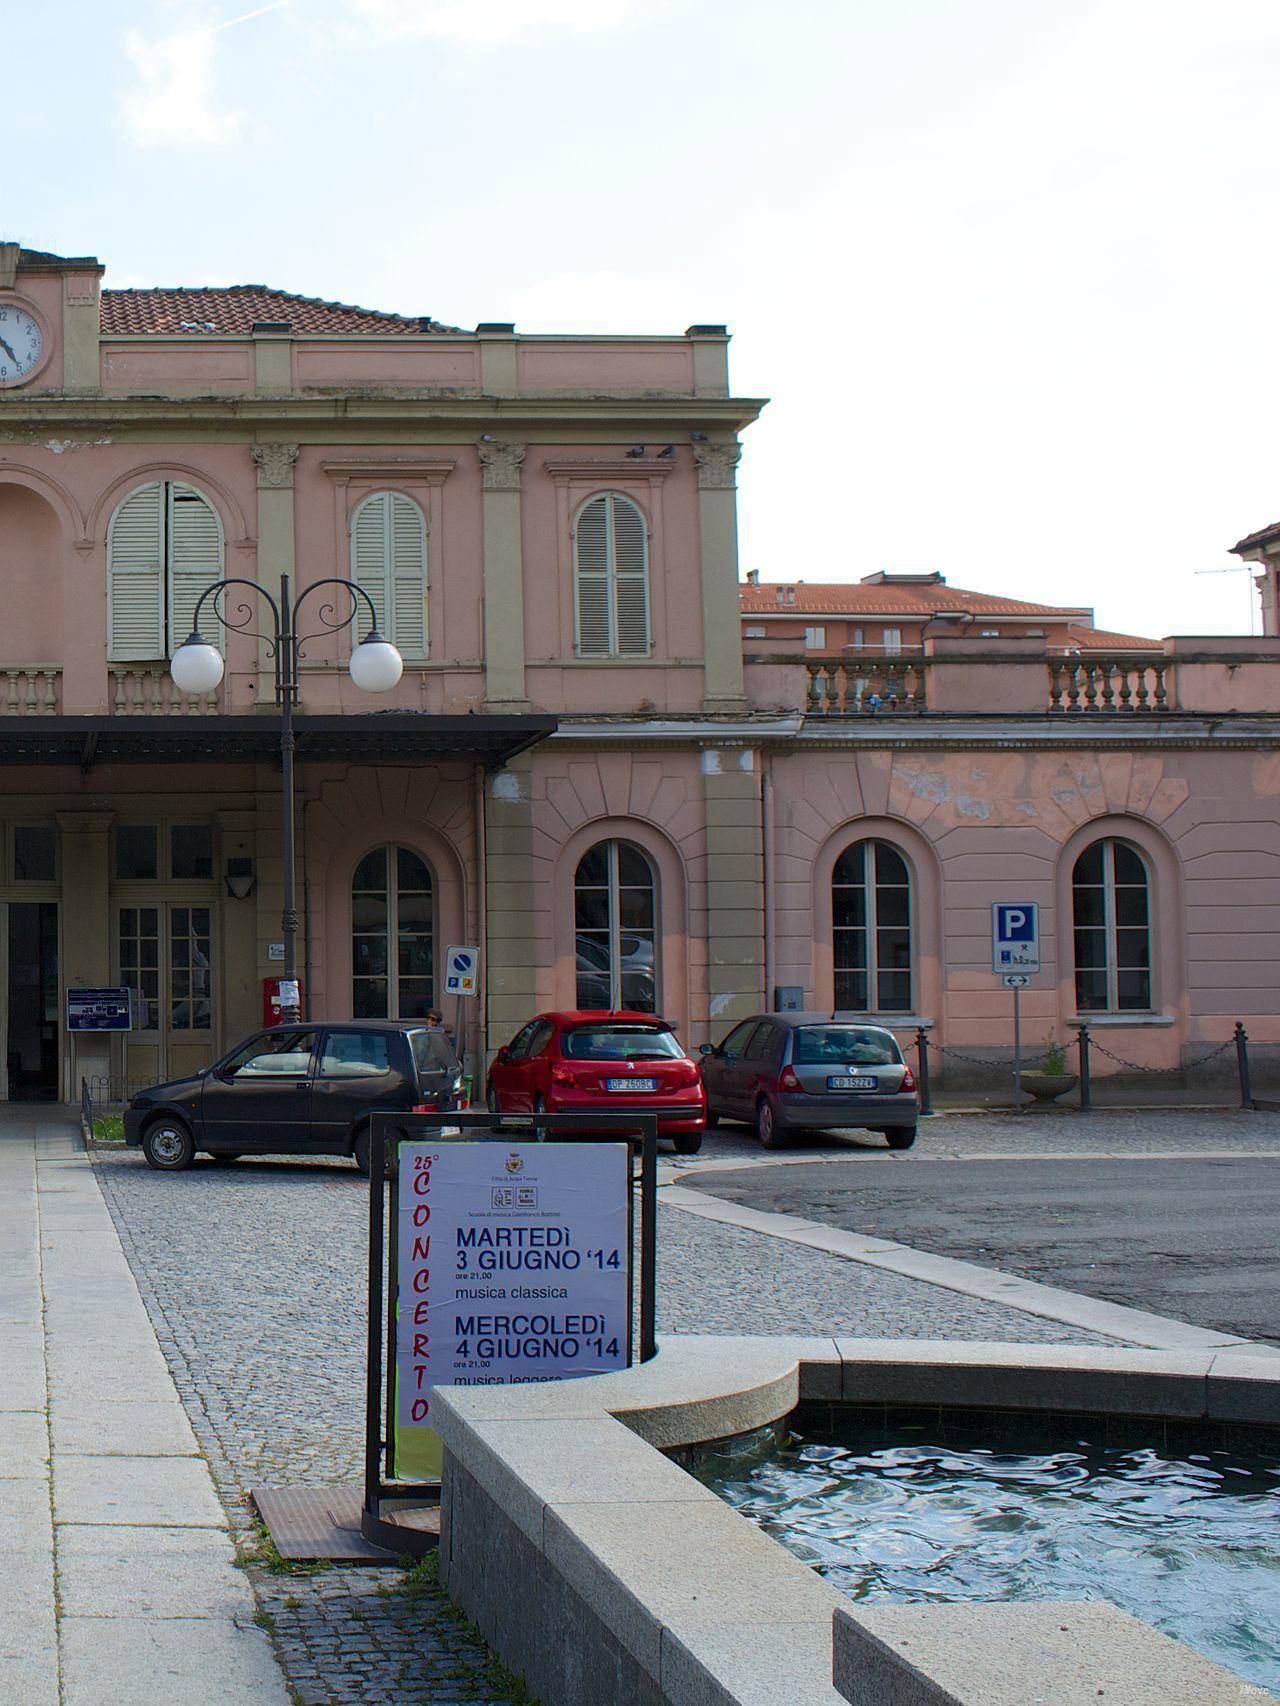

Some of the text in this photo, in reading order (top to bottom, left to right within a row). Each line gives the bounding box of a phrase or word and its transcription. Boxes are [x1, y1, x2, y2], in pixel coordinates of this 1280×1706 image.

[0, 311, 7, 321] 12
[26, 326, 31, 335] 2
[31, 339, 36, 348] 3
[27, 352, 31, 361] 4
[1, 367, 7, 376] 6
[17, 363, 21, 371] 5
[1005, 910, 1026, 938] P
[612, 1079, 623, 1089] DP
[414, 1154, 439, 1170] 25°
[456, 1227, 570, 1247] MARTEDì
[456, 1250, 468, 1270] 3
[478, 1249, 581, 1270] GIUGNO
[411, 1171, 431, 1422] CONCERTO
[455, 1285, 568, 1299] musica classica
[455, 1314, 606, 1336] MERCOLEDì
[456, 1339, 470, 1359] 4
[477, 1338, 580, 1359] GIUGNO
[454, 1374, 505, 1386] musica
